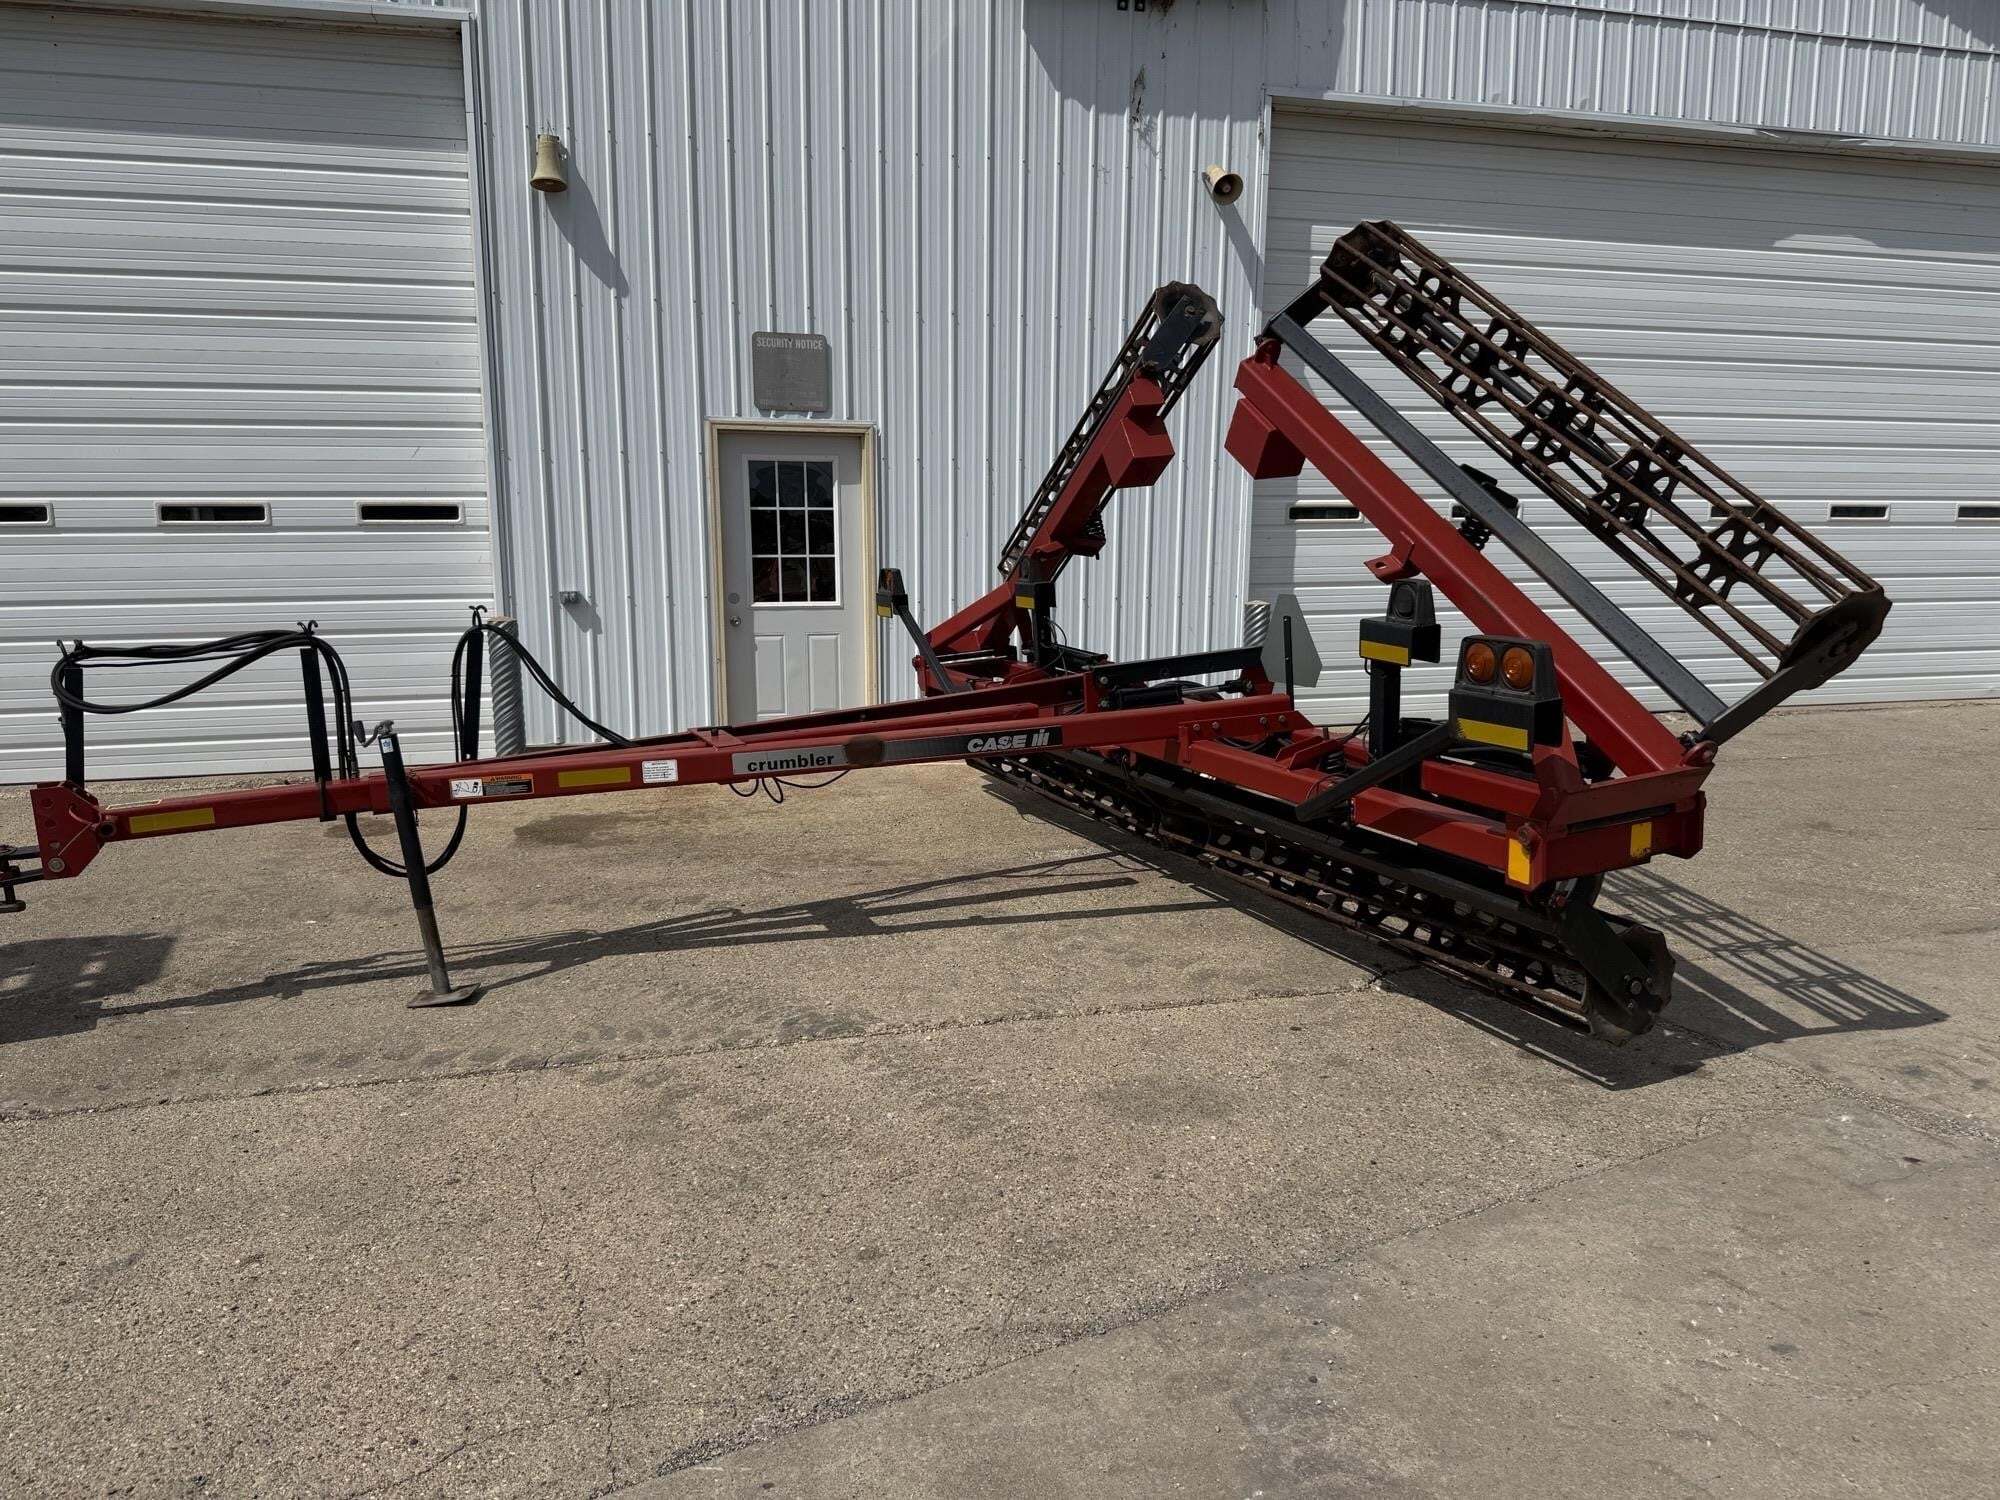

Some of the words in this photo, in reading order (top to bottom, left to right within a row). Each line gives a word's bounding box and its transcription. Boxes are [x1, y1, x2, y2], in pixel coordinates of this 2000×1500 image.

[756, 337, 793, 349] SECURITY
[795, 339, 824, 350] NOTICE
[967, 734, 1028, 752] CASE
[747, 753, 835, 772] crumbler
